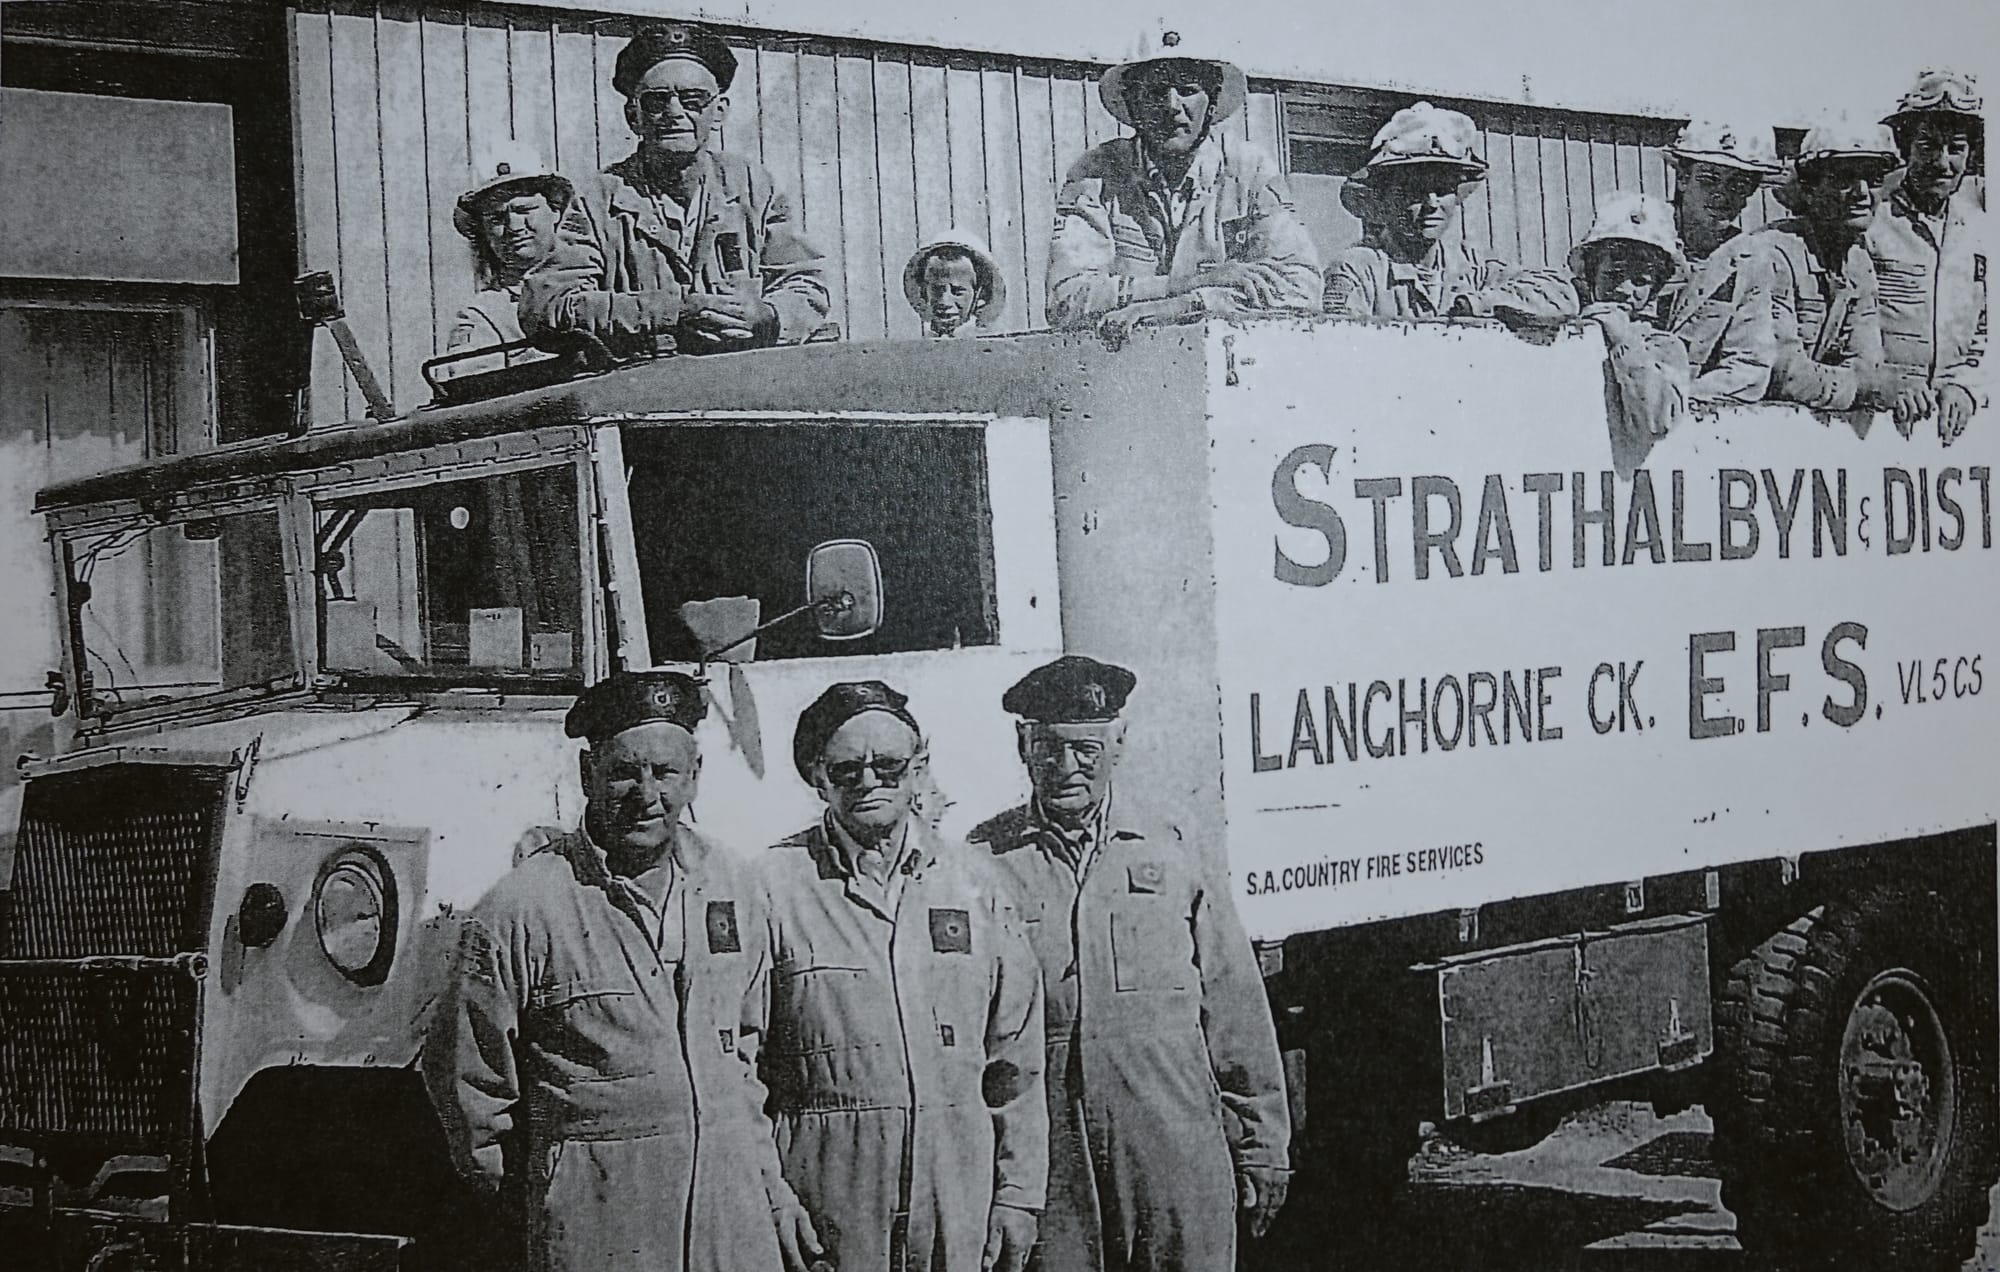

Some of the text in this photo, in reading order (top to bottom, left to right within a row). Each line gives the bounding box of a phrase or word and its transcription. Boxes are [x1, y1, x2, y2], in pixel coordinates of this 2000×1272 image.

[1271, 443, 1847, 587] STRATHALBYN
[1883, 466, 1992, 556] DIST
[1250, 666, 1563, 773] LANGHORNE
[1588, 660, 1655, 735] CK.
[1689, 621, 1882, 740] E.F.S.
[1367, 854, 1401, 879] FIRE
[1406, 842, 1484, 873] SERVICES
